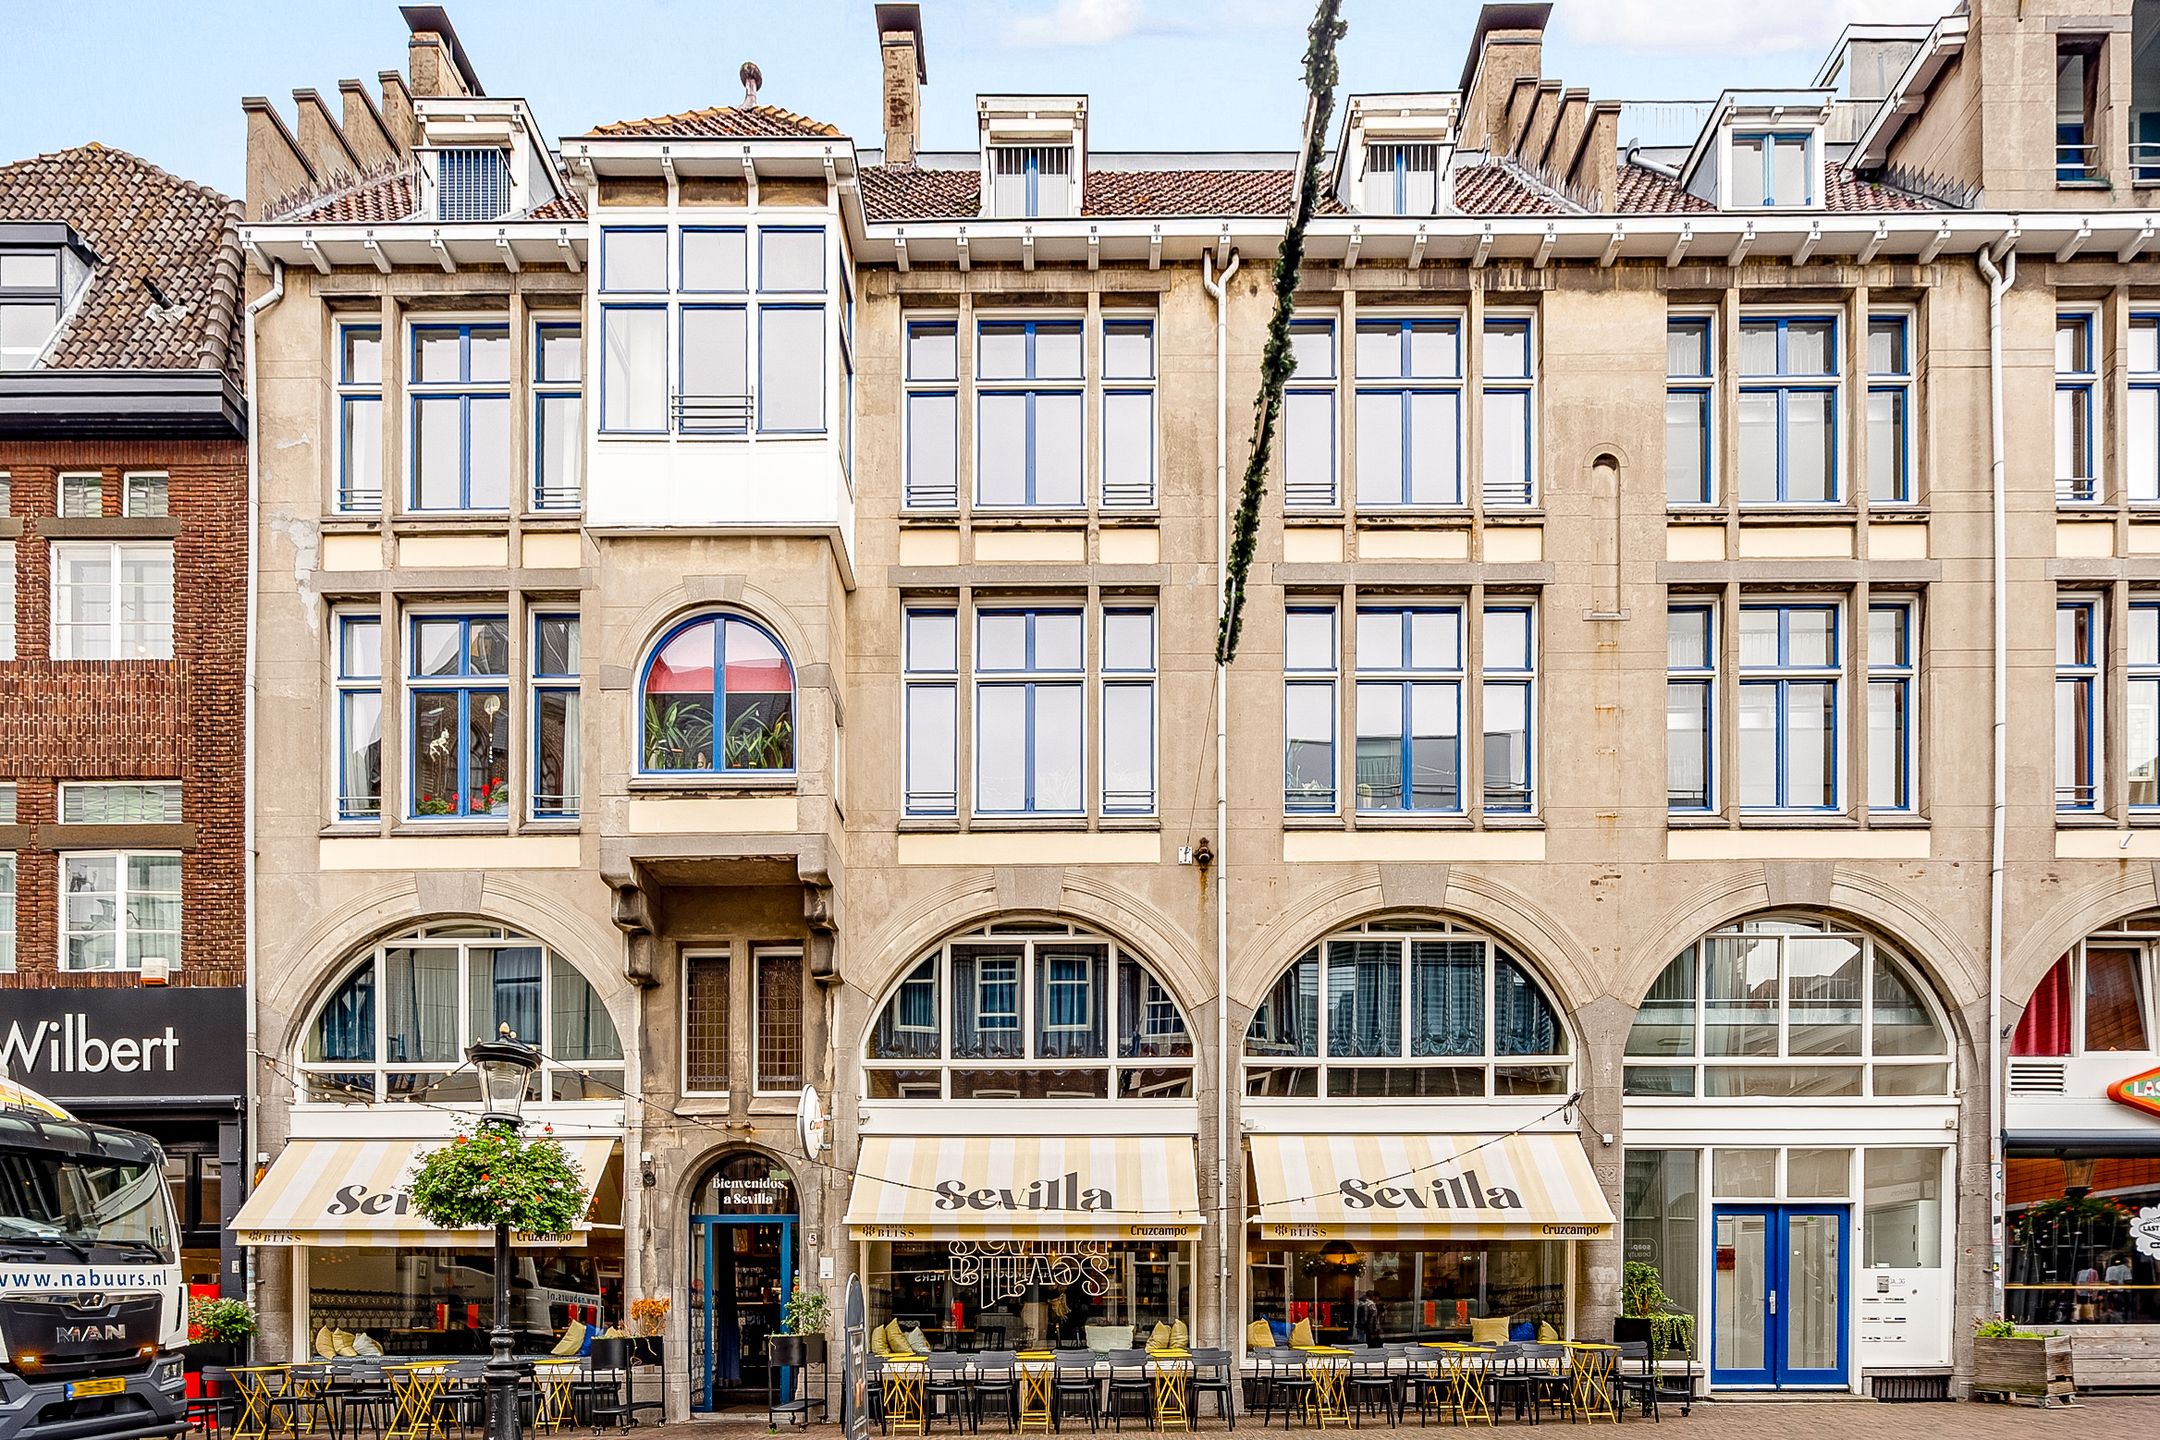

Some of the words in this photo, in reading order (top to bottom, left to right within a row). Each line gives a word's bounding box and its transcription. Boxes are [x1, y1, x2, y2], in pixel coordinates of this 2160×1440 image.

[0, 1013, 180, 1074] Wilbert
[712, 1178, 785, 1189] Bienvenidos
[1339, 1170, 1525, 1210] Sevilla
[935, 1171, 1112, 1211] Sevilla
[723, 1195, 732, 1205] a
[733, 1192, 773, 1205] Sevilla
[878, 1229, 915, 1238] BLISS
[1130, 1225, 1188, 1238] Cruzcampo
[1290, 1228, 1327, 1237] BLISS
[1542, 1223, 1600, 1237] Cruzcampo
[263, 1234, 302, 1242] BLISS
[56, 1324, 126, 1344] MAN
